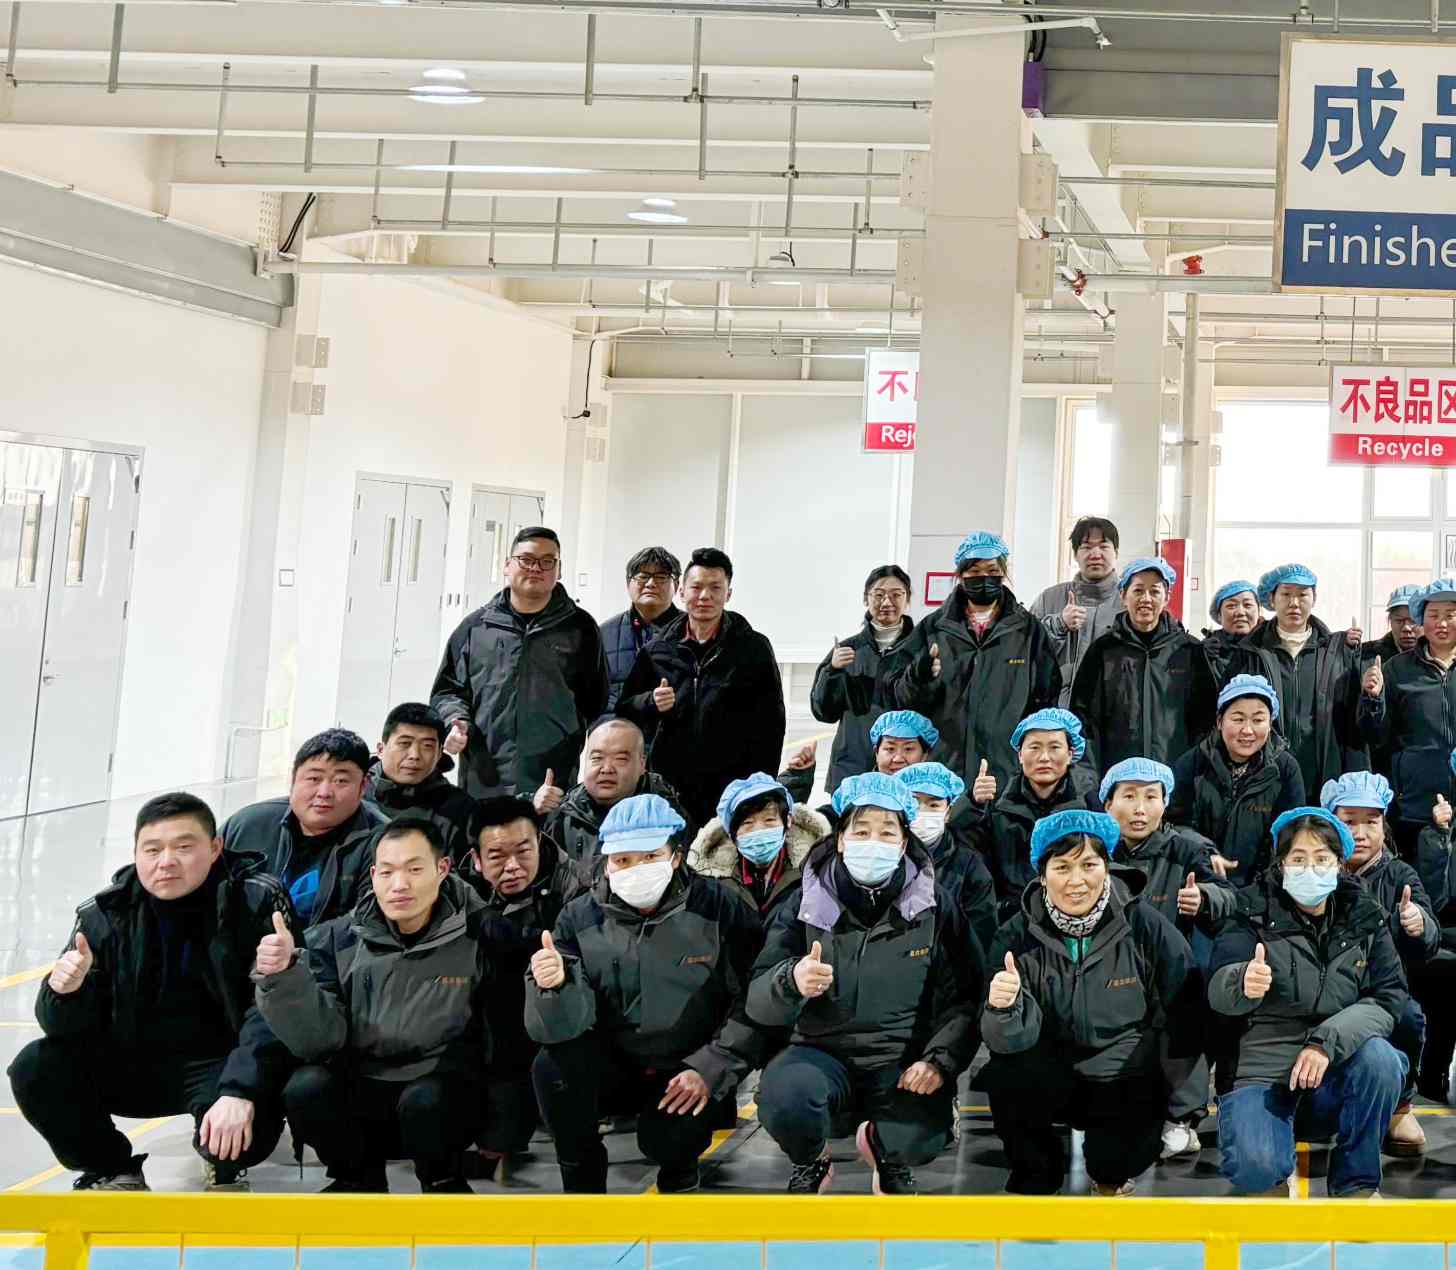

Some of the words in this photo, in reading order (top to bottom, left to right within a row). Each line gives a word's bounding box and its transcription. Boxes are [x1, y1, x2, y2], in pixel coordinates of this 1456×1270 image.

[877, 370, 919, 401] 不
[881, 425, 917, 448] Rej
[1357, 436, 1444, 459] Recycle
